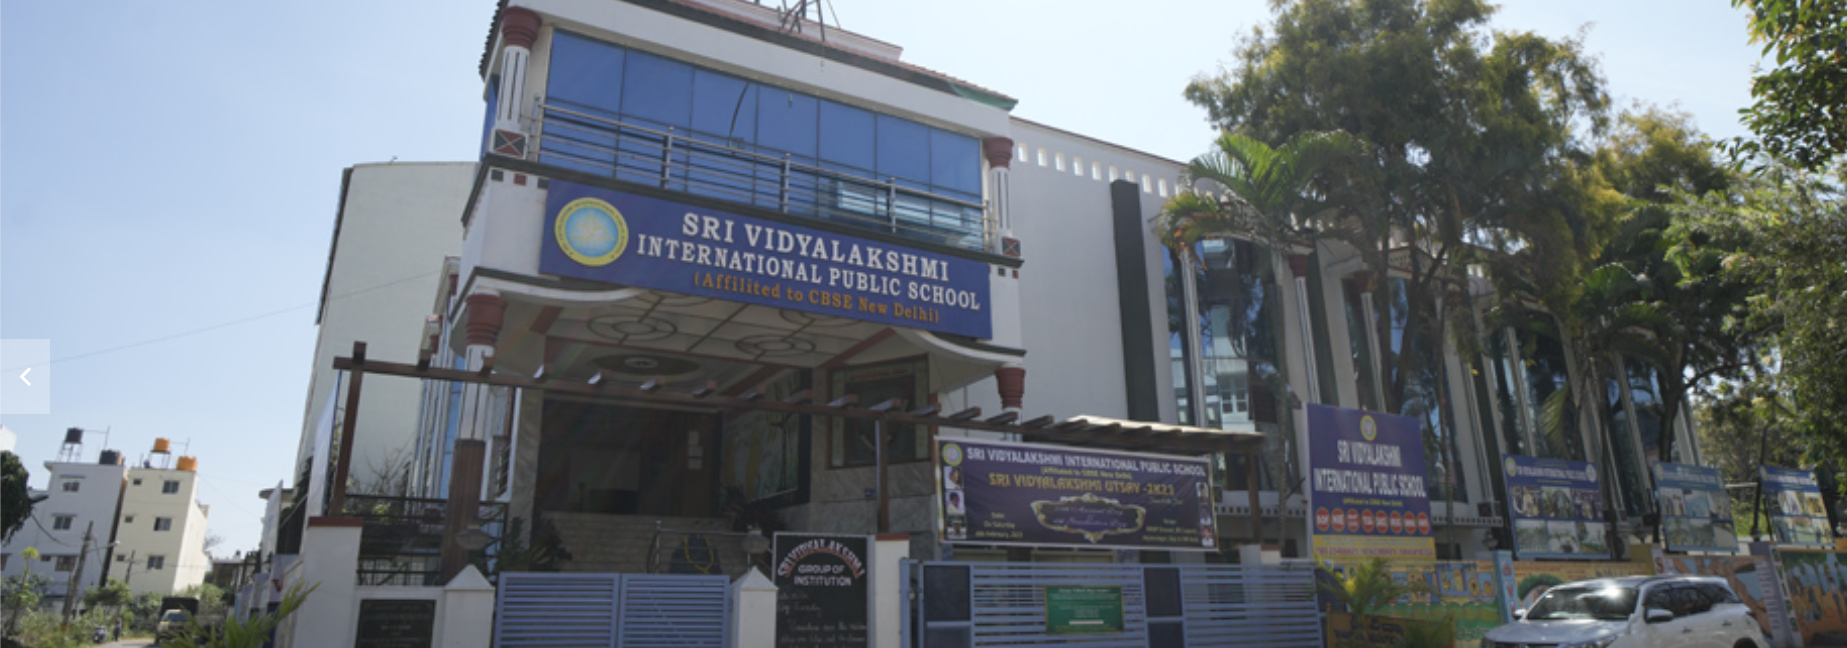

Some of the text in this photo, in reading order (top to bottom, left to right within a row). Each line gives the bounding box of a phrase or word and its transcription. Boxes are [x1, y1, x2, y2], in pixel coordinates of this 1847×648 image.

[682, 213, 950, 283] SRI VIDYALAKSHMI
[637, 234, 981, 311] INTERNATIONAL PUBLIC SCHOOL
[694, 271, 940, 324] (Affilited to CBSE New Delhi)
[967, 447, 1206, 477] SRI VIDYALAKSHMI INTERNATIONAL PUBLIC SCHOOL
[1337, 440, 1350, 463] SRI
[988, 473, 1011, 487] SRI
[1014, 474, 1102, 491] VIDYALAKSHMI
[1105, 481, 1141, 495] UTSAV
[1313, 468, 1372, 494] INTERNATIONAL
[793, 574, 852, 586] INSTITUTION
[798, 564, 845, 574] GROUP OF
